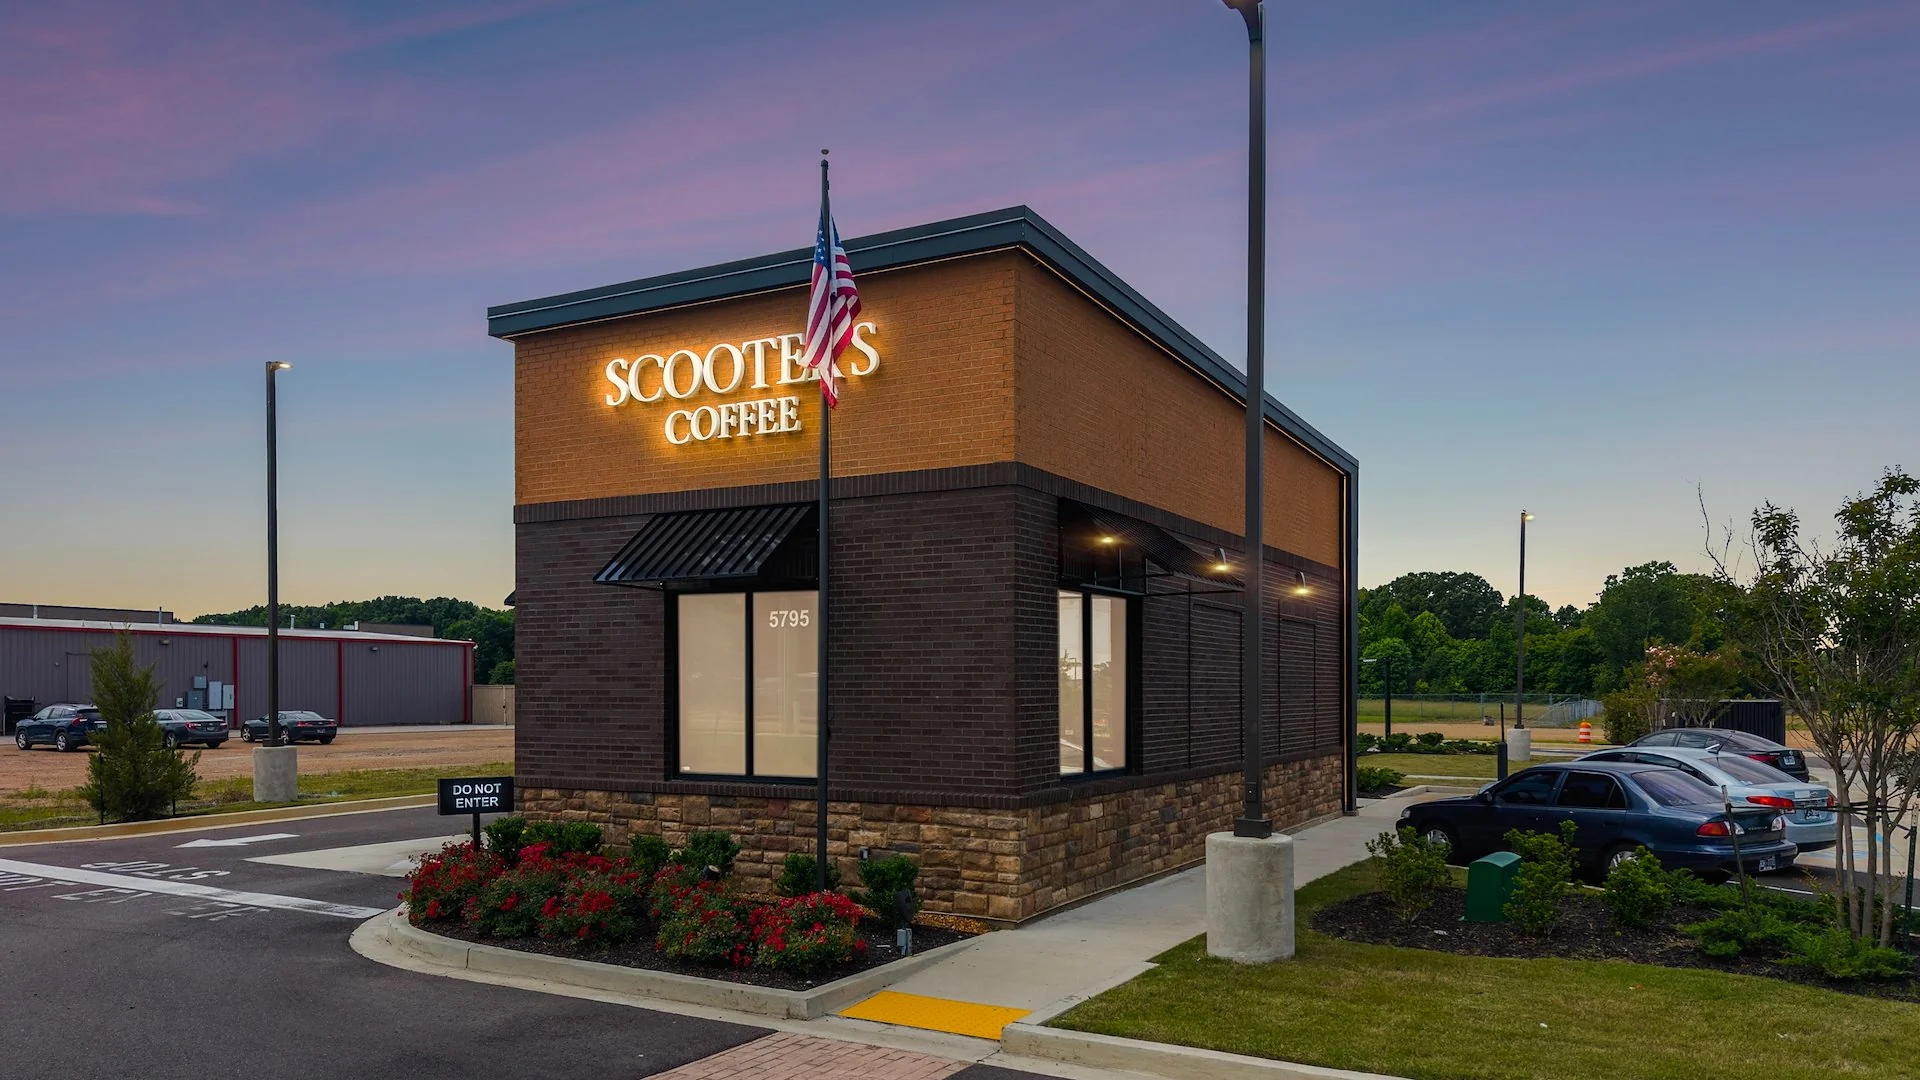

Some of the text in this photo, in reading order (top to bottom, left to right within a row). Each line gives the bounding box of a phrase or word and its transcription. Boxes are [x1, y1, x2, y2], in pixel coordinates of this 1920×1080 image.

[605, 322, 881, 407] SCOOTES
[664, 396, 802, 445] COFFEE
[769, 609, 809, 628] 5795
[453, 783, 501, 796] DO NOT
[456, 796, 499, 808] ENTER
[80, 860, 231, 880] STOP
